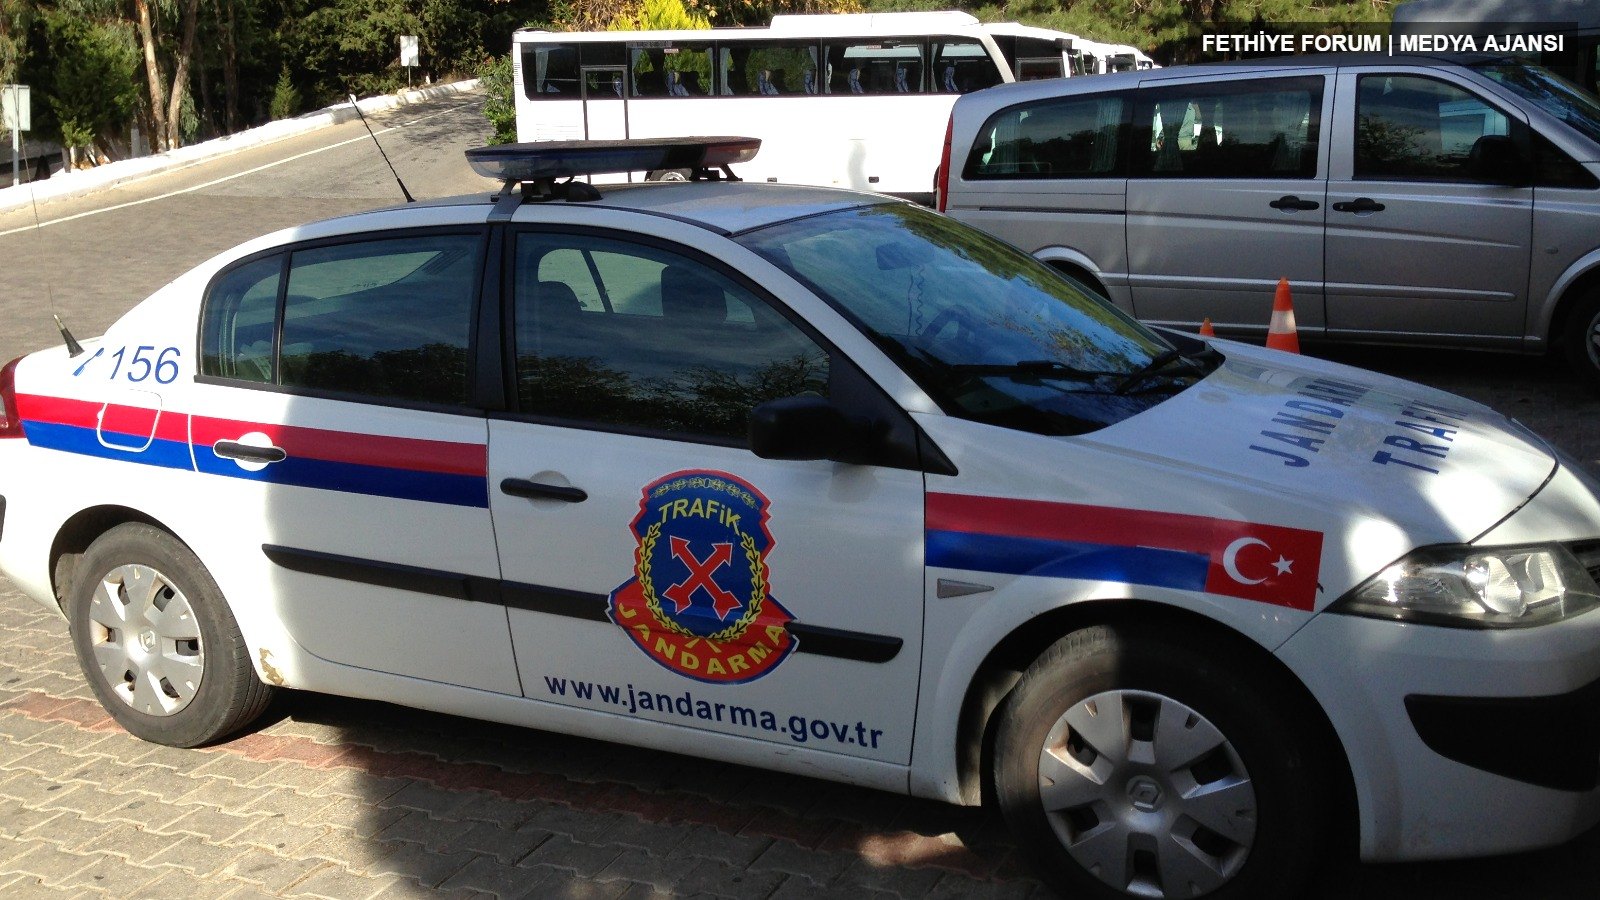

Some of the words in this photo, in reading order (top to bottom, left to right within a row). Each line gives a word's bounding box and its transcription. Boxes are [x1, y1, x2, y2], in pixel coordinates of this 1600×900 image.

[109, 345, 181, 384] 156
[1249, 378, 1374, 468] JANDARM
[618, 602, 786, 675] JANDARMA
[544, 675, 883, 749] www.jandarma.gov.tr
